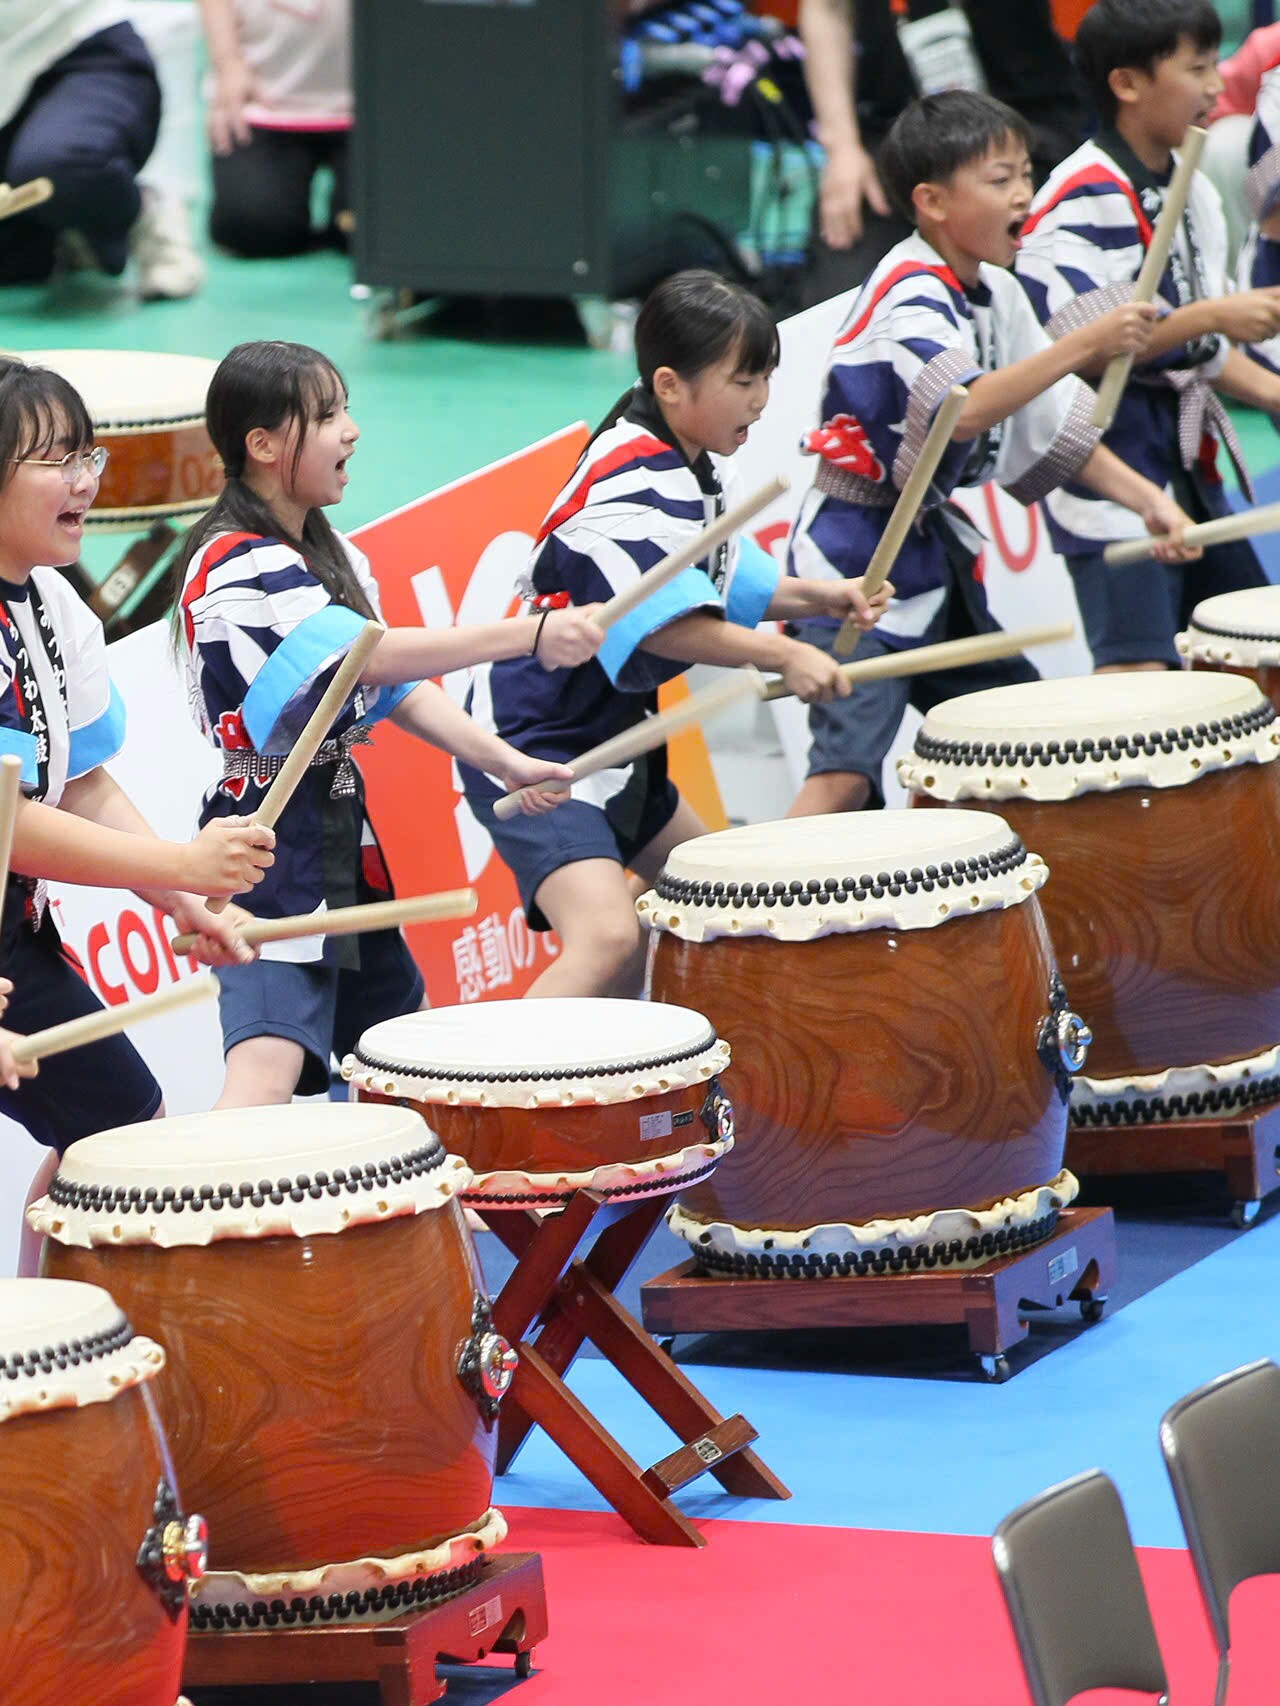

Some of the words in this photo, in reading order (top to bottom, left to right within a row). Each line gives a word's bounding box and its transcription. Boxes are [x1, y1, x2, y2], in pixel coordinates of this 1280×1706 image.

[7, 617, 49, 803] みつわ太鼓
